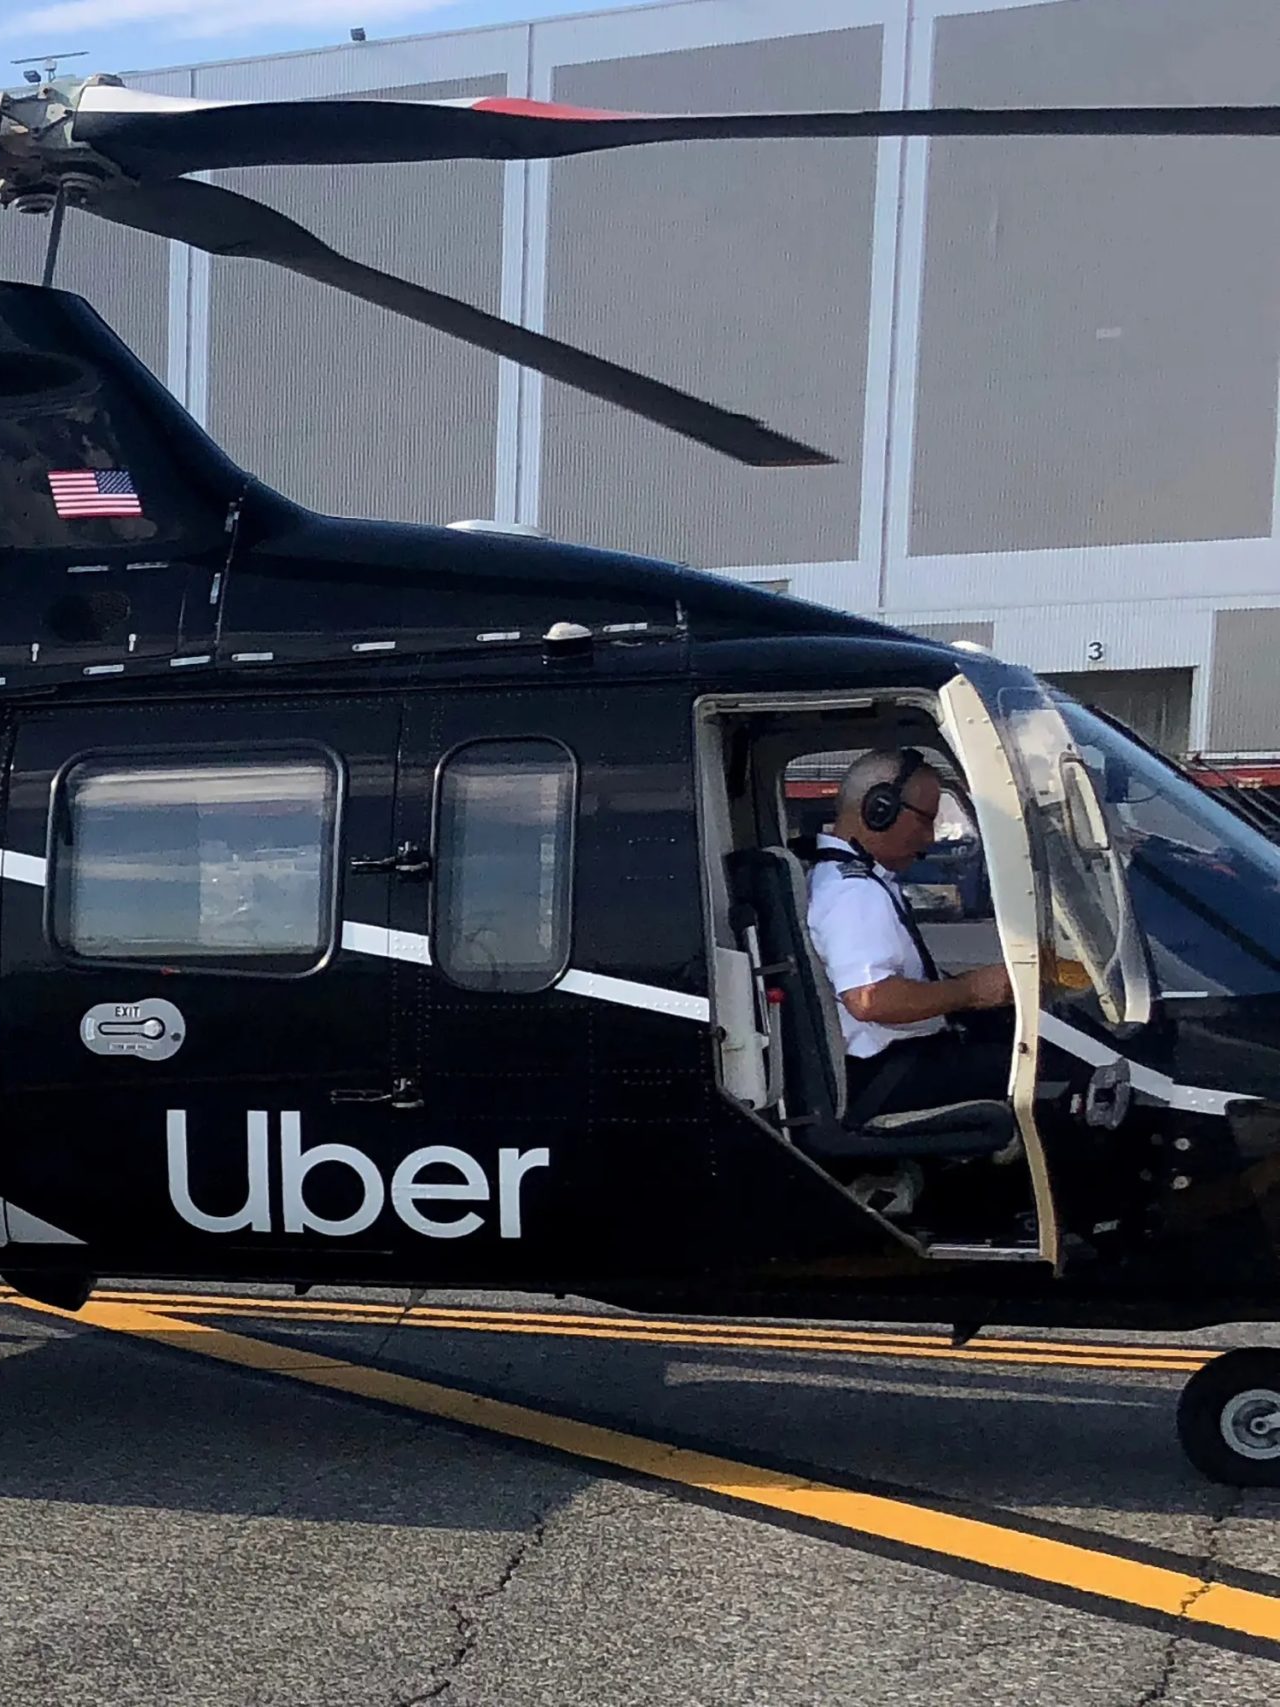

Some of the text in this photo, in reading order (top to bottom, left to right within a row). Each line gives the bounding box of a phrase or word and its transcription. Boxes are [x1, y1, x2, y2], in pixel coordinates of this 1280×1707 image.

[1088, 641, 1103, 660] 3
[115, 1006, 140, 1017] EXIT
[166, 1109, 550, 1239] Uber
